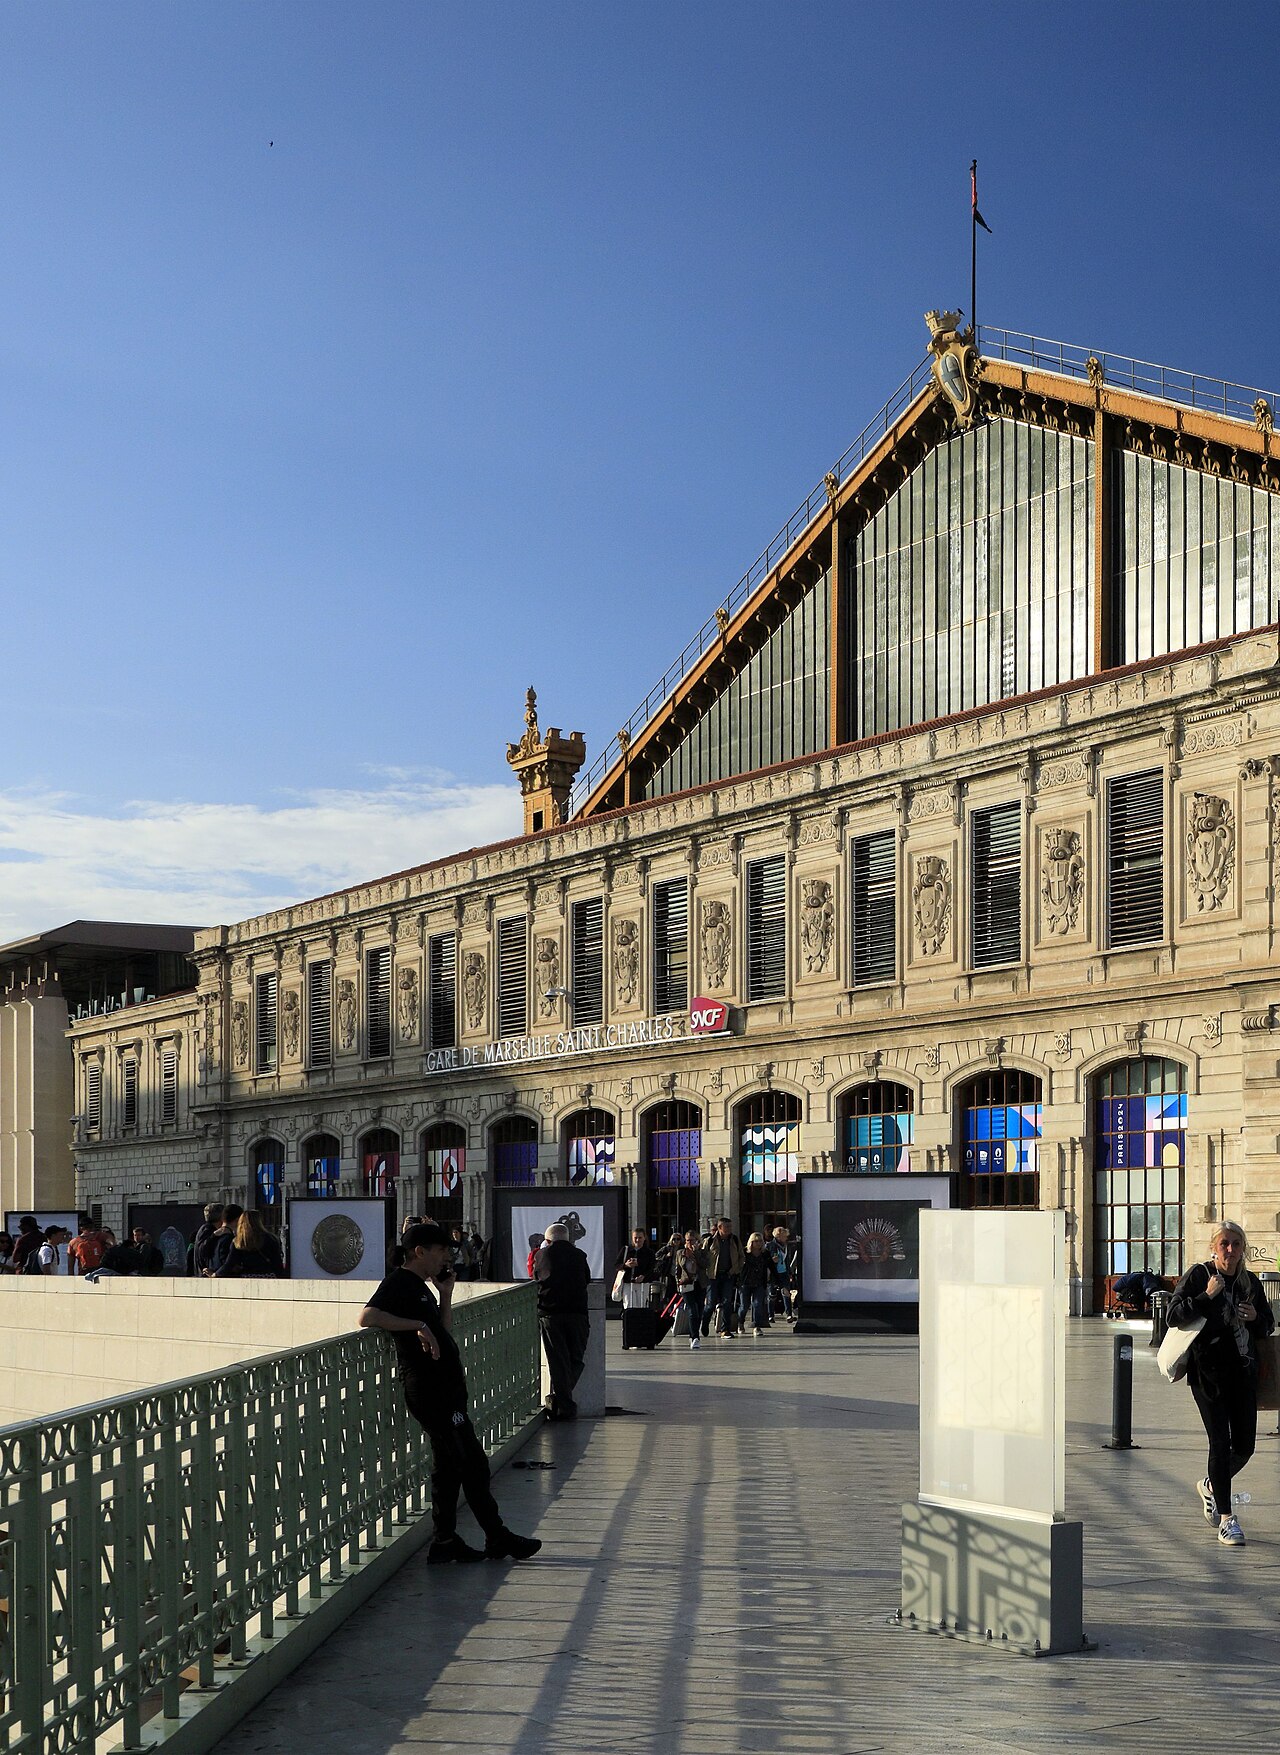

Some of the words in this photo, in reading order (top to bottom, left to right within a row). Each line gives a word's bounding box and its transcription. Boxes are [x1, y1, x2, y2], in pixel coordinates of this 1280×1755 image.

[691, 1008, 722, 1029] SNCF
[427, 1049, 458, 1071] GARE
[463, 1046, 479, 1066] DE
[485, 1034, 551, 1062] MARSEILLE
[557, 1027, 600, 1053] SAINT
[606, 1016, 673, 1046] CHARLES
